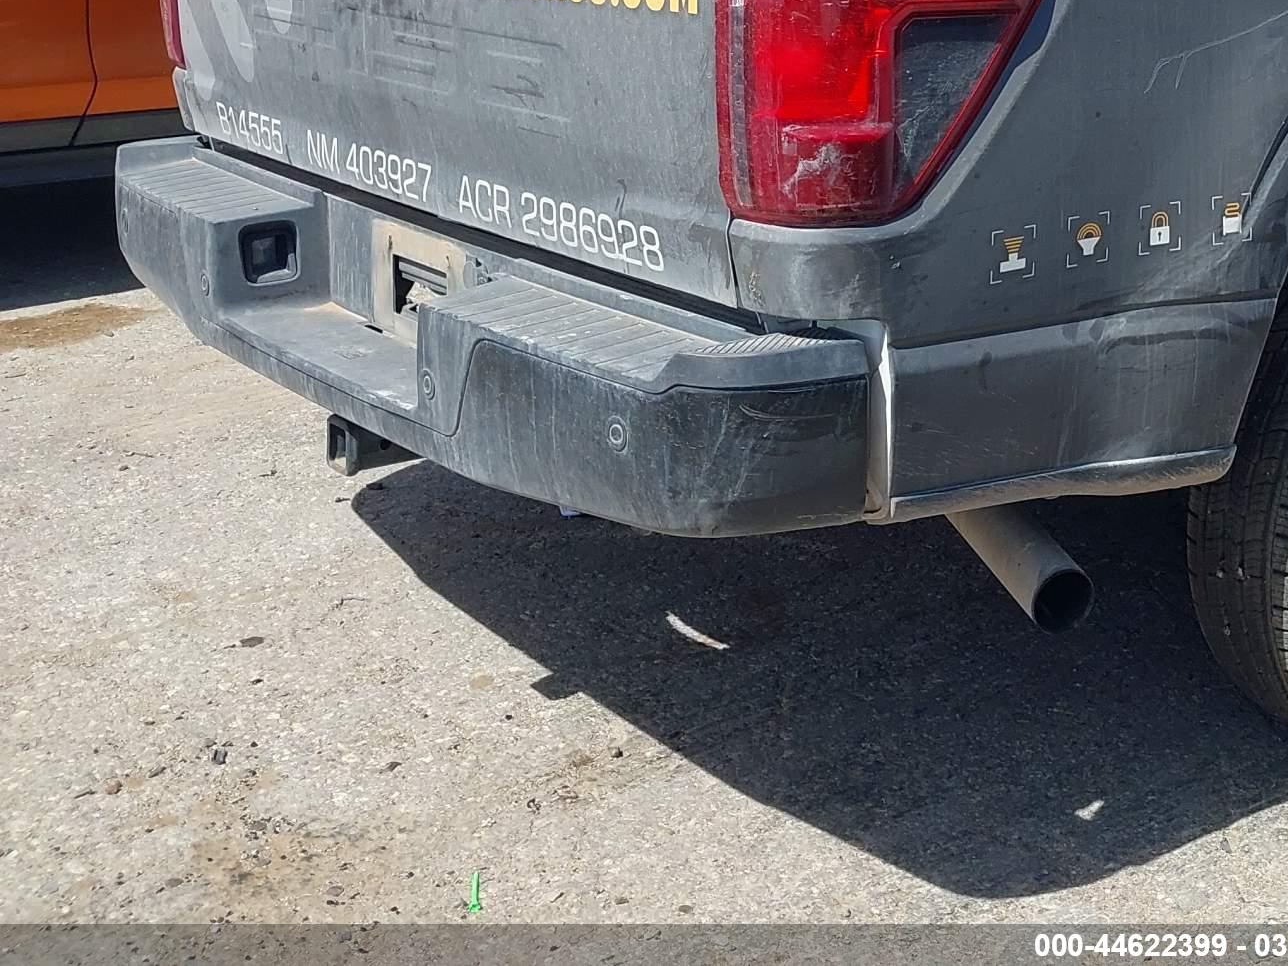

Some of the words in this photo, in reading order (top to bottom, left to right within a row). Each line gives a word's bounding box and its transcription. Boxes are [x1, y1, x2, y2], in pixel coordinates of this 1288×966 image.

[216, 101, 284, 156] B14555
[306, 129, 340, 174] NM
[345, 143, 432, 203] 403927
[458, 175, 512, 228] ACR
[520, 192, 665, 272] 2986928
